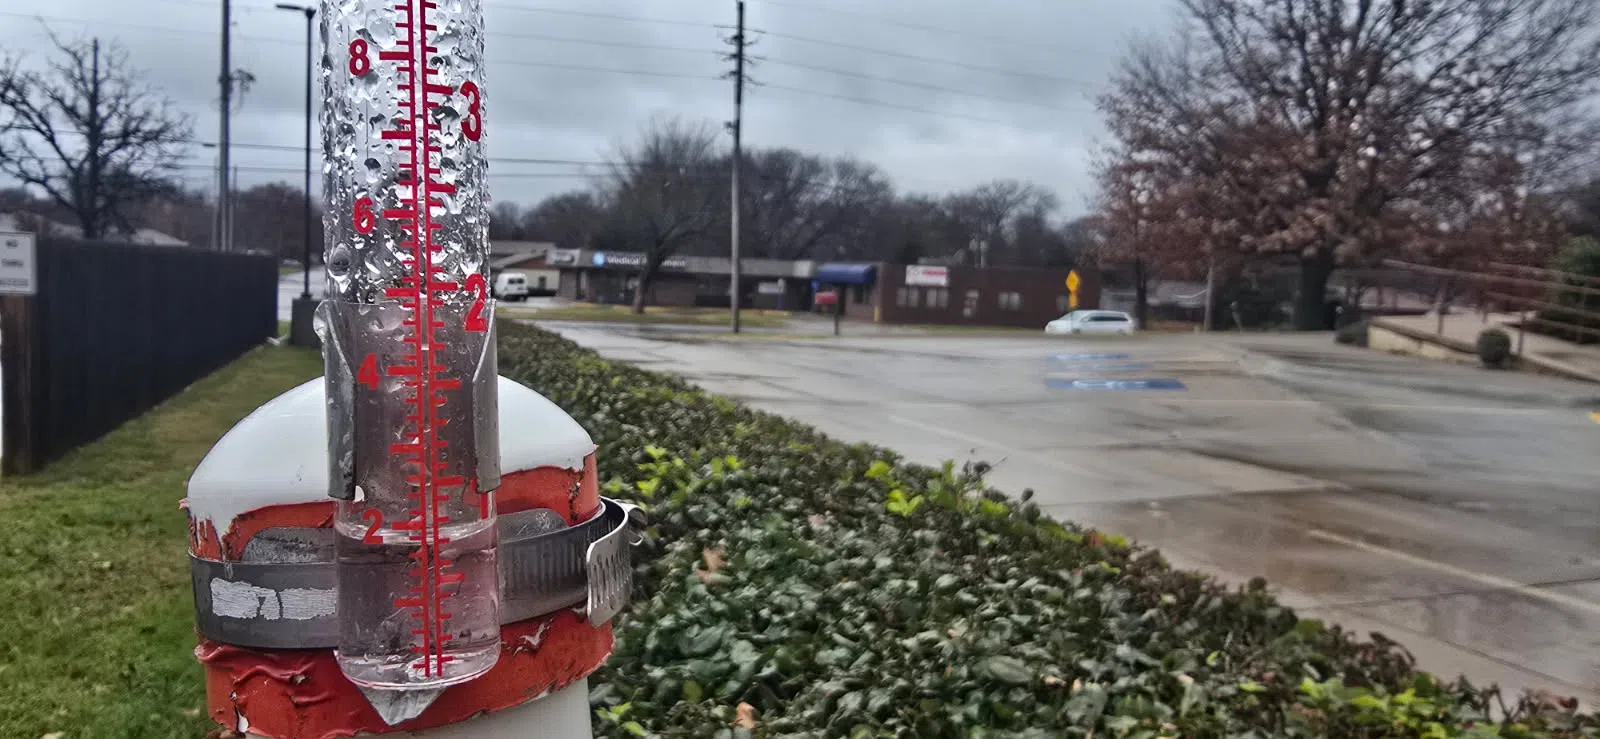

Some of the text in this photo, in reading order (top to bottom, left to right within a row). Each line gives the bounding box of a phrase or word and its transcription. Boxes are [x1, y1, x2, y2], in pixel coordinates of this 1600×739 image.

[349, 38, 370, 76] 8
[459, 80, 482, 142] 3
[352, 196, 376, 234] 6
[607, 255, 640, 266] Medical
[464, 273, 488, 332] 2
[356, 352, 381, 391] 4
[361, 507, 384, 545] 2
